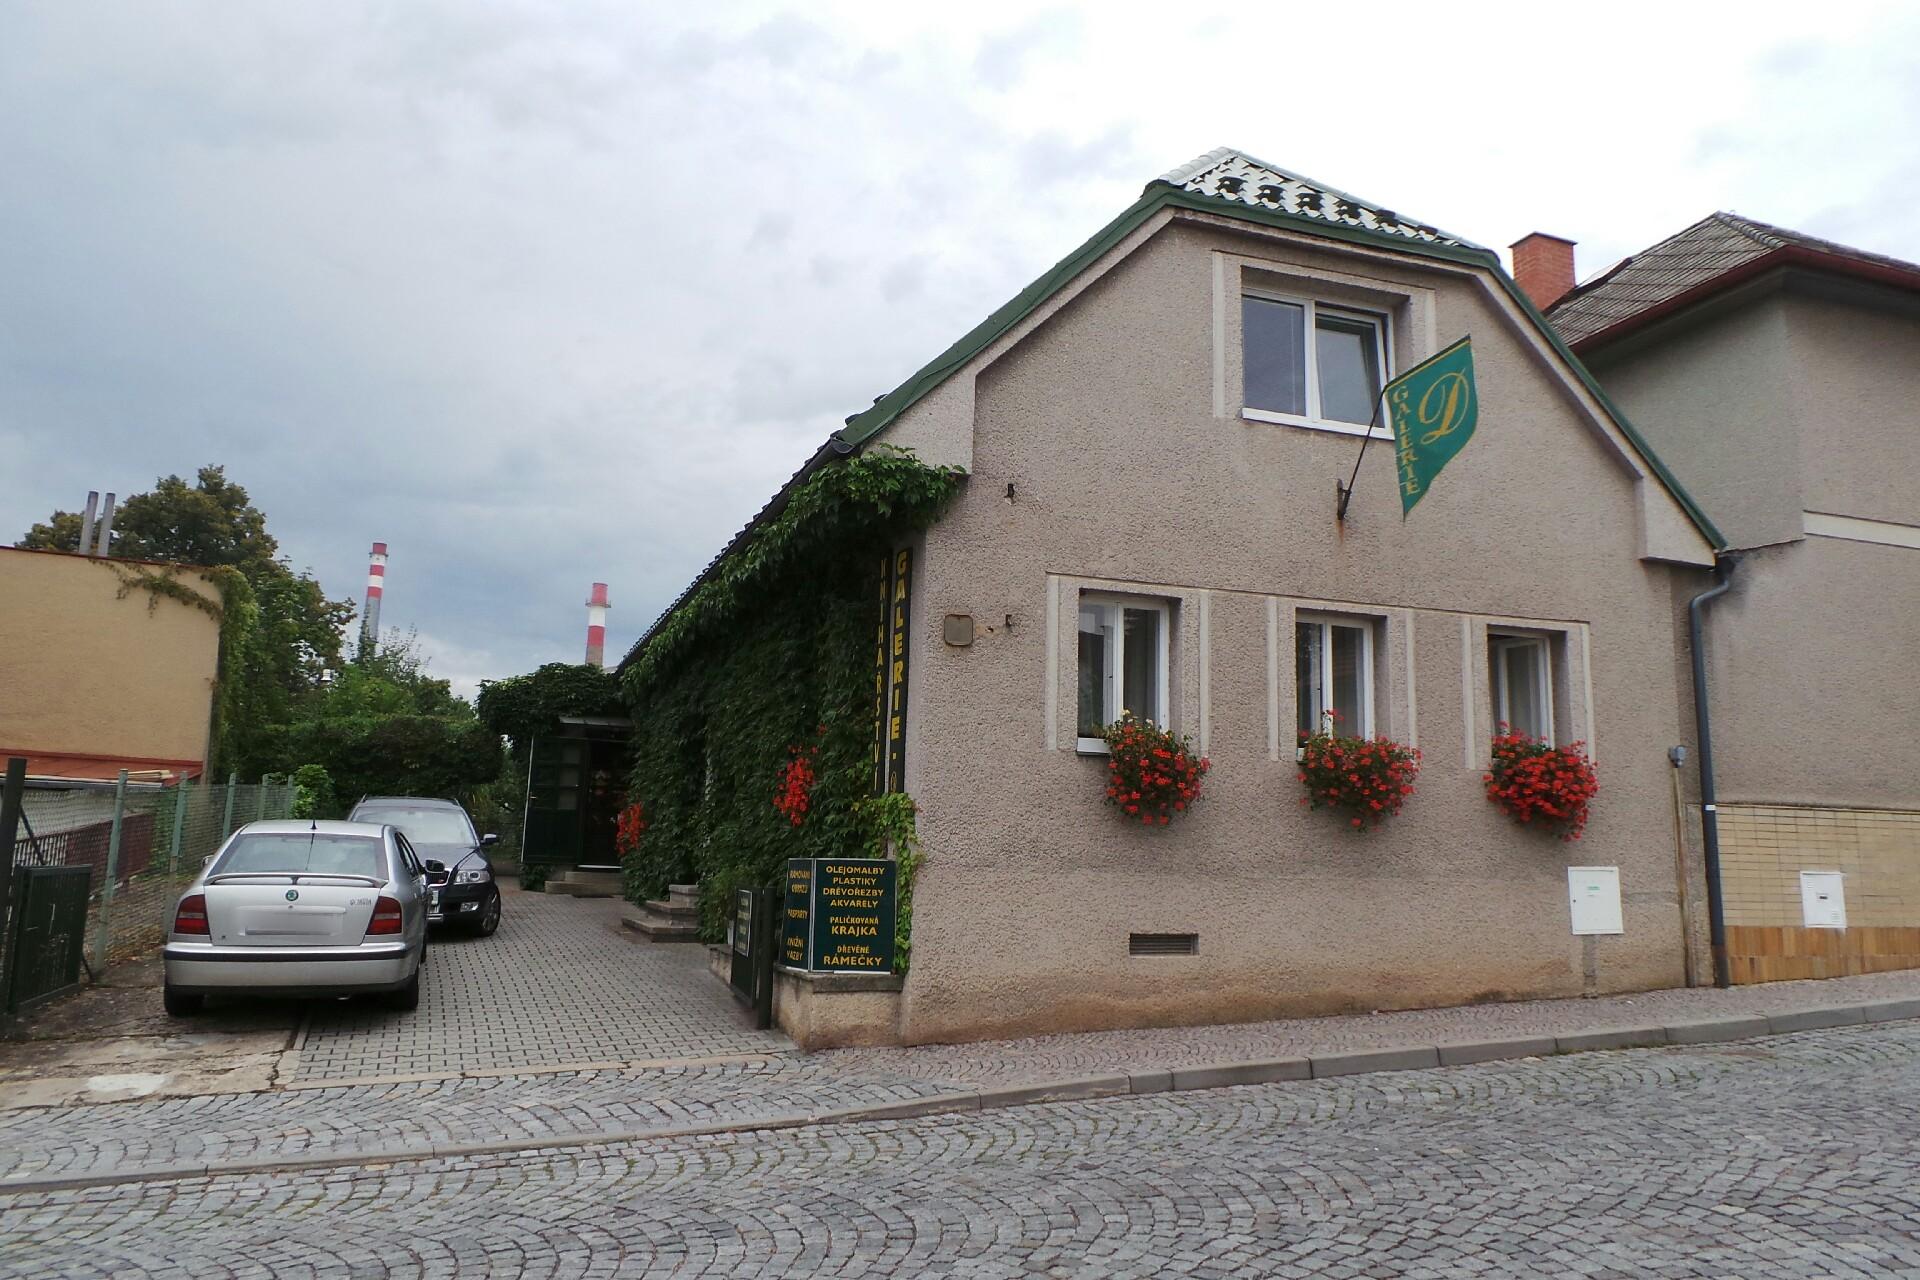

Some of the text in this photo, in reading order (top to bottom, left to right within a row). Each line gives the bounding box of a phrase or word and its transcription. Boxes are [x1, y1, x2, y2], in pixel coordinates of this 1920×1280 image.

[826, 865, 885, 875] OLEJOMALBY
[833, 877, 876, 885] PLASTIKY
[830, 899, 878, 908] AKVARELY
[831, 925, 878, 937] KRAJKA
[823, 953, 882, 966] RÁMEČKY
